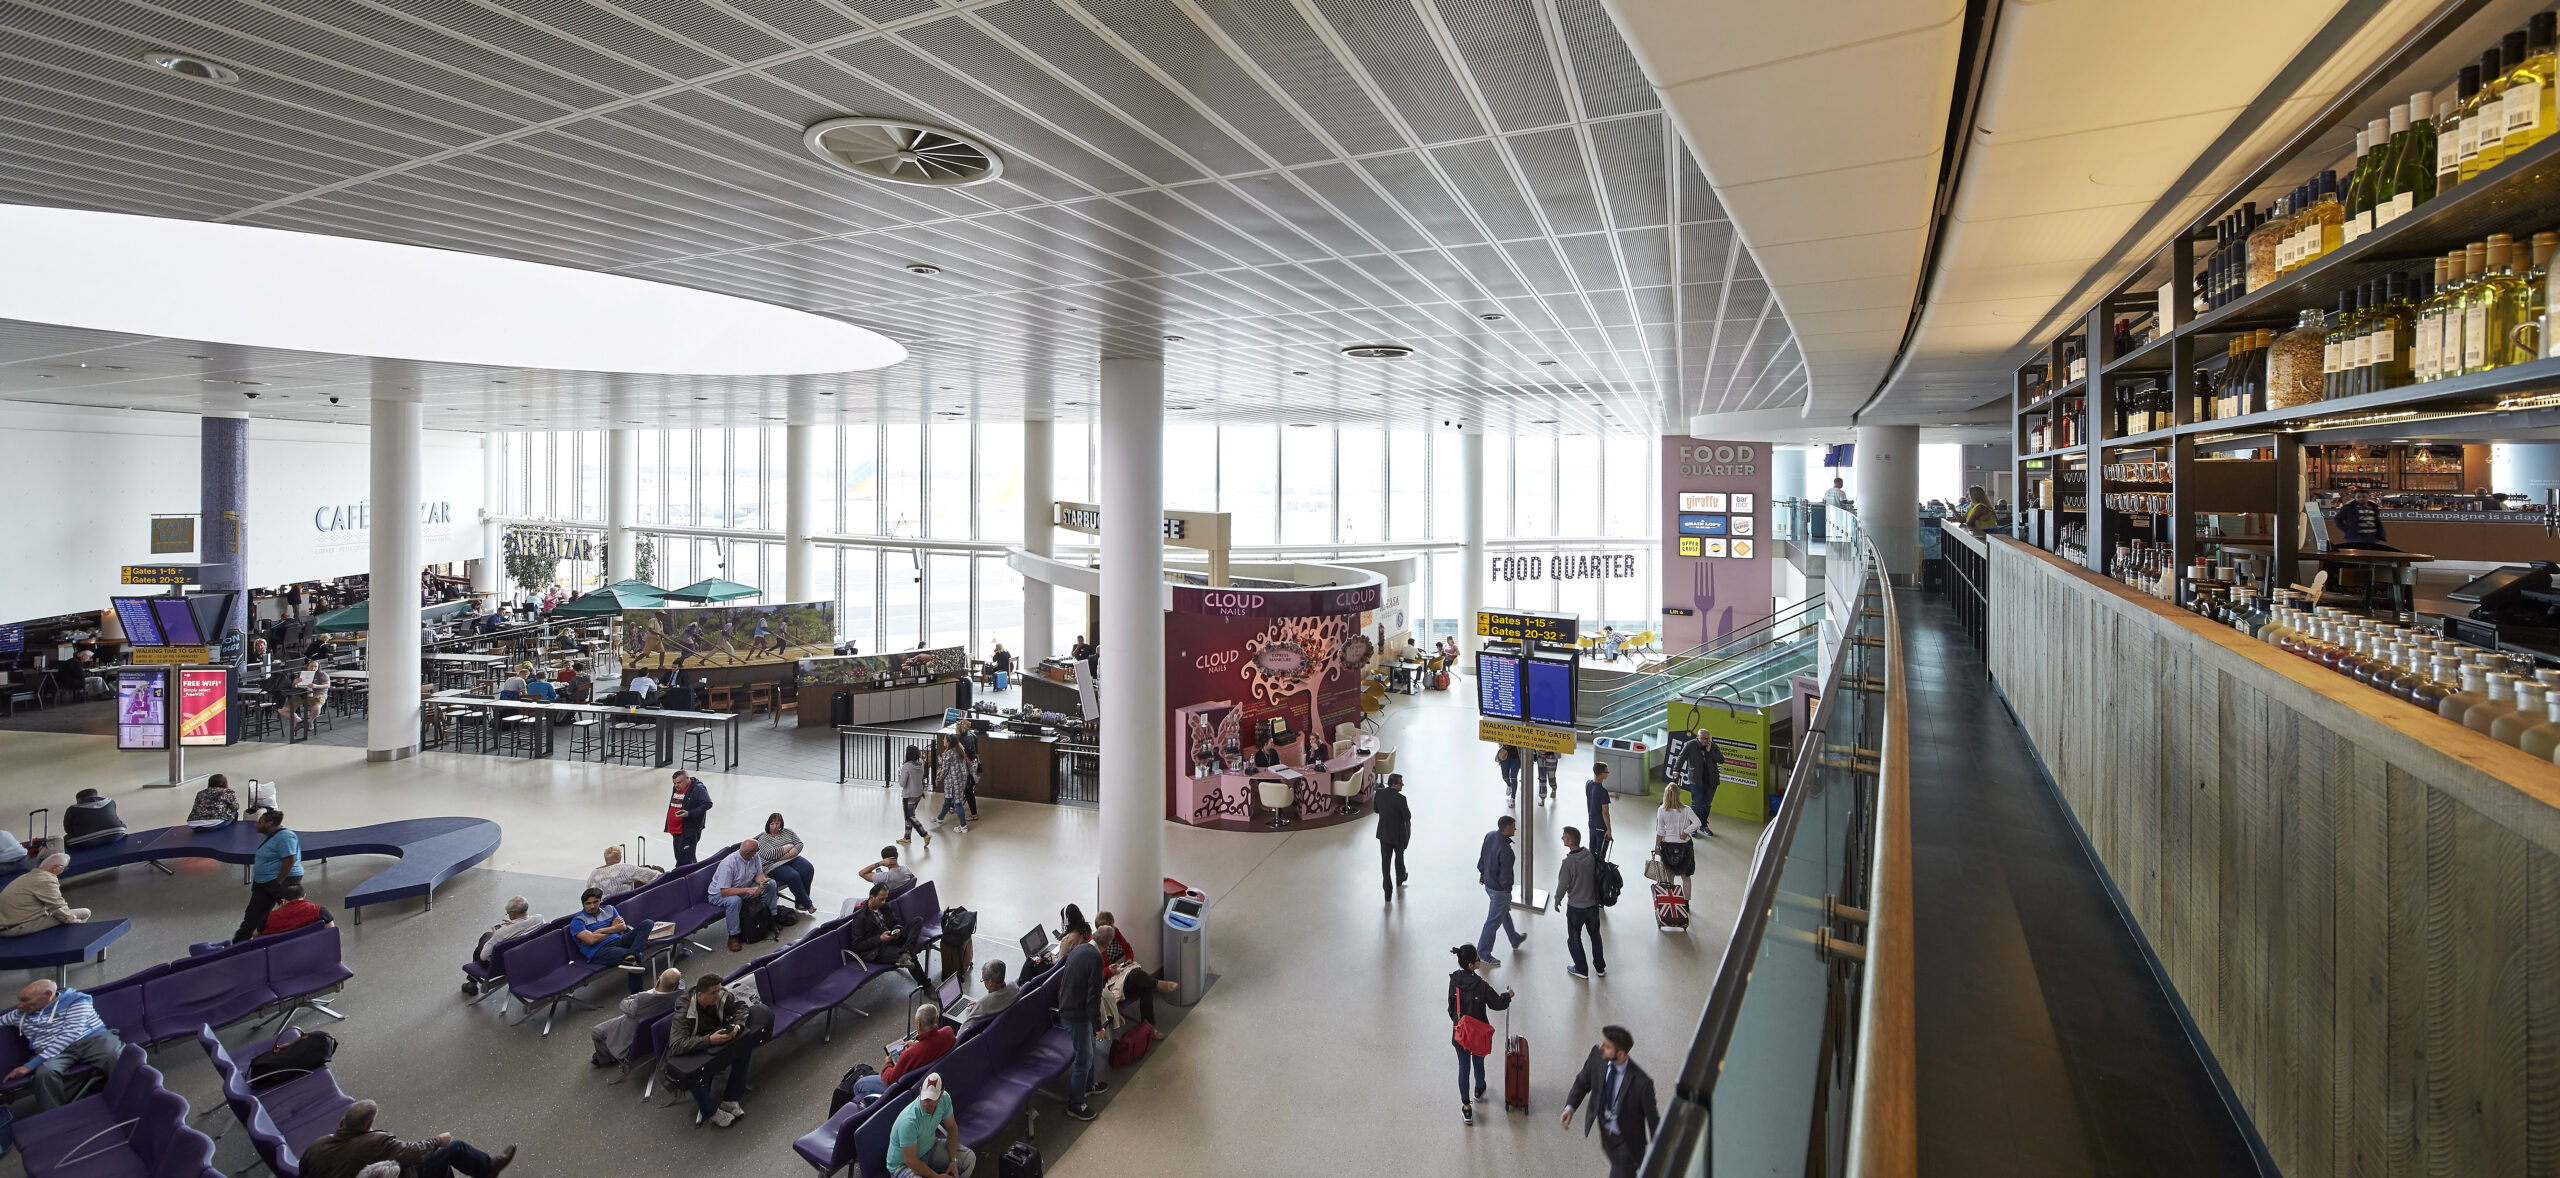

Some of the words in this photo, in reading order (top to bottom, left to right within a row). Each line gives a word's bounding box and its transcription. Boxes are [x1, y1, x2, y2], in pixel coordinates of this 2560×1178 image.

[1680, 446, 1755, 463] FOOD
[1680, 465, 1755, 478] QUARTER
[1686, 496, 1718, 508] giraffe
[421, 501, 452, 524] ZAR
[1064, 508, 1100, 529] STARBU
[2406, 511, 2485, 520] Champagne
[2489, 511, 2499, 520] is
[2515, 512, 2540, 522] day
[540, 536, 594, 560] BALZAR
[1492, 556, 1542, 582] FOOD
[1550, 554, 1634, 580] QUARTER
[132, 576, 156, 584] Gates
[1204, 593, 1264, 609] CLOUD
[1336, 588, 1375, 607] CLOUD
[1220, 608, 1246, 616] NAILS
[1350, 604, 1366, 612] NAILS
[1491, 615, 1521, 626] Gates
[1524, 618, 1546, 628] 1-15
[1491, 626, 1521, 637] Gates
[1524, 629, 1557, 640] 20-32
[1196, 650, 1239, 669] CLOUD
[1208, 664, 1227, 674] NAILS
[1482, 722, 1516, 732] WALKING
[1517, 726, 1534, 735] TIME
[1548, 731, 1571, 740] GATES
[1535, 743, 1558, 751] MINUTES
[1538, 737, 1560, 745] MINUTES
[1730, 776, 1756, 785] RYANAIR
